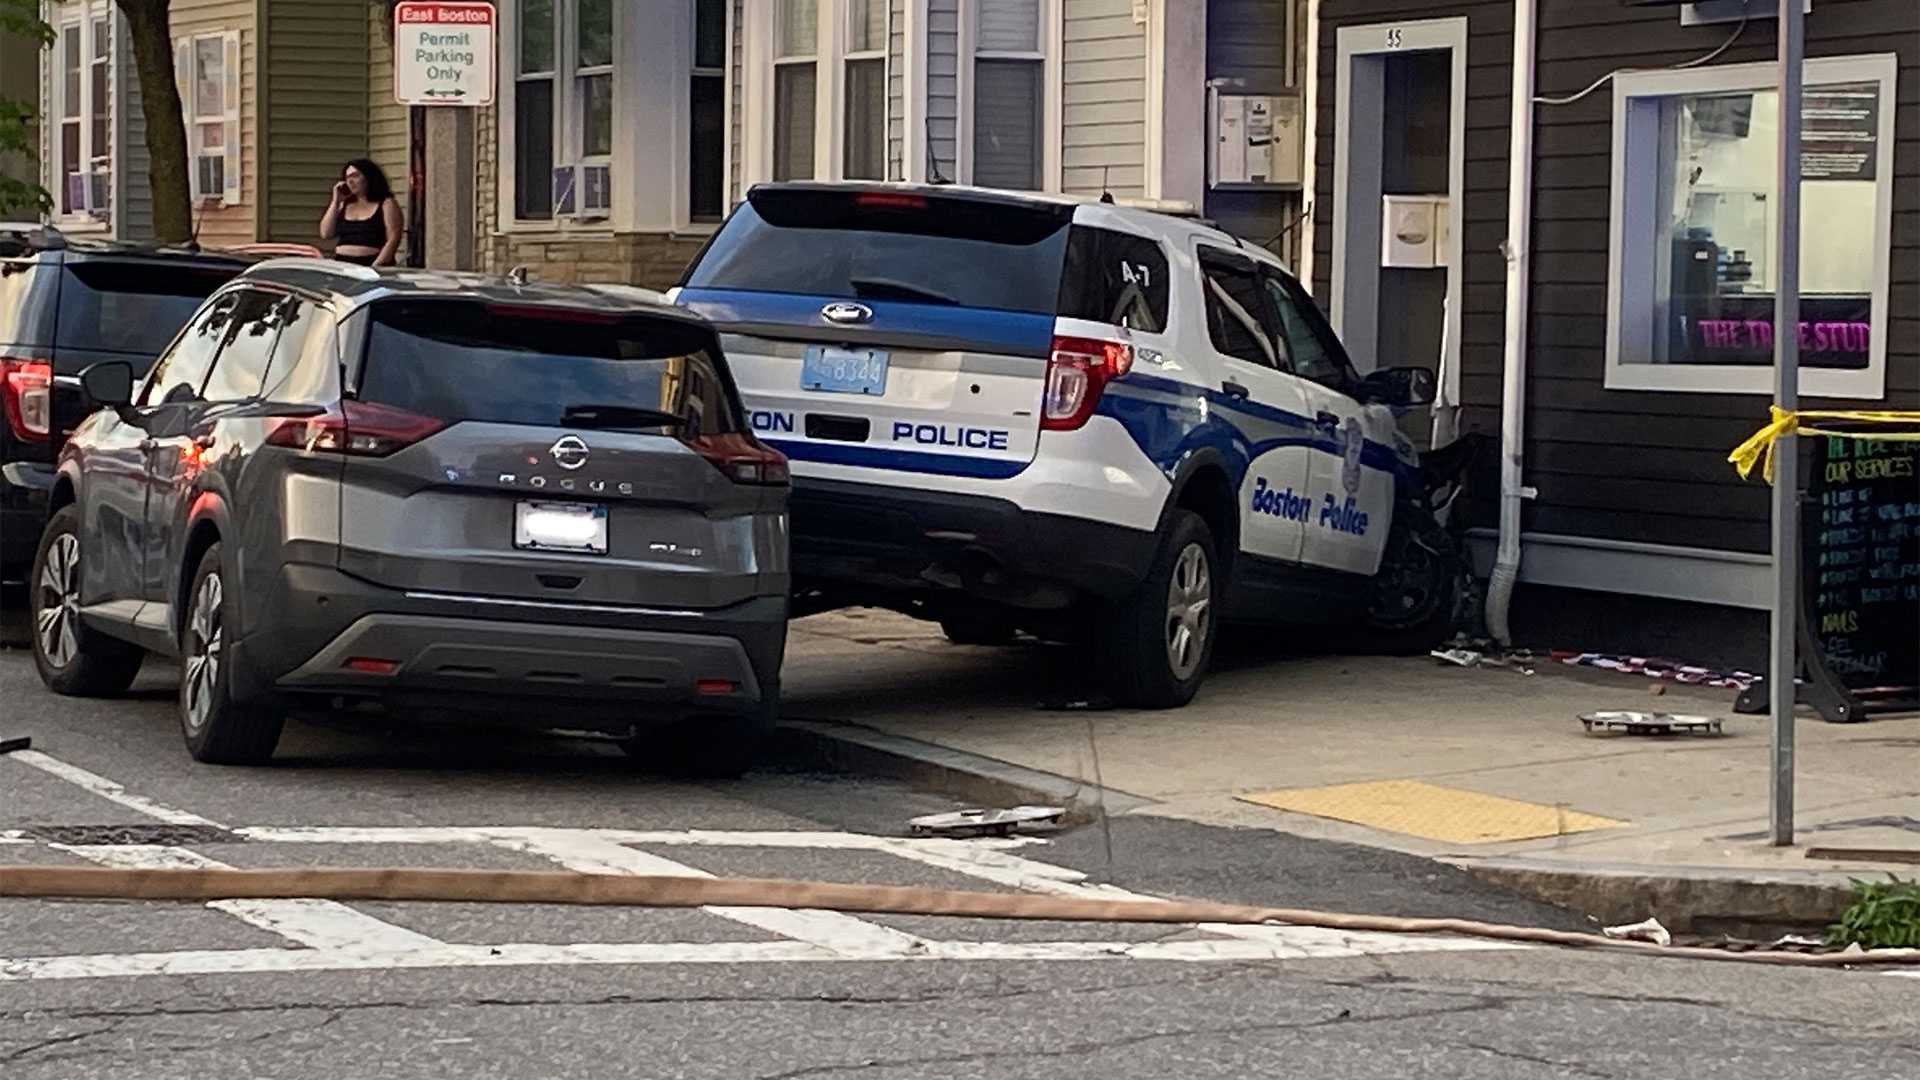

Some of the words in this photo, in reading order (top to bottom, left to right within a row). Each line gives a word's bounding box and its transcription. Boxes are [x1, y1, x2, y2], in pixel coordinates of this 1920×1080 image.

[402, 7, 433, 22] East
[438, 8, 488, 22] Boston
[420, 32, 470, 46] Permit
[416, 49, 474, 66] Parking
[426, 66, 462, 82] Only
[1698, 319, 1743, 348] THE
[892, 422, 1009, 451] POLICE
[1825, 461, 1852, 484] OUR
[1252, 477, 1312, 523] Boston
[1319, 493, 1369, 536] Police
